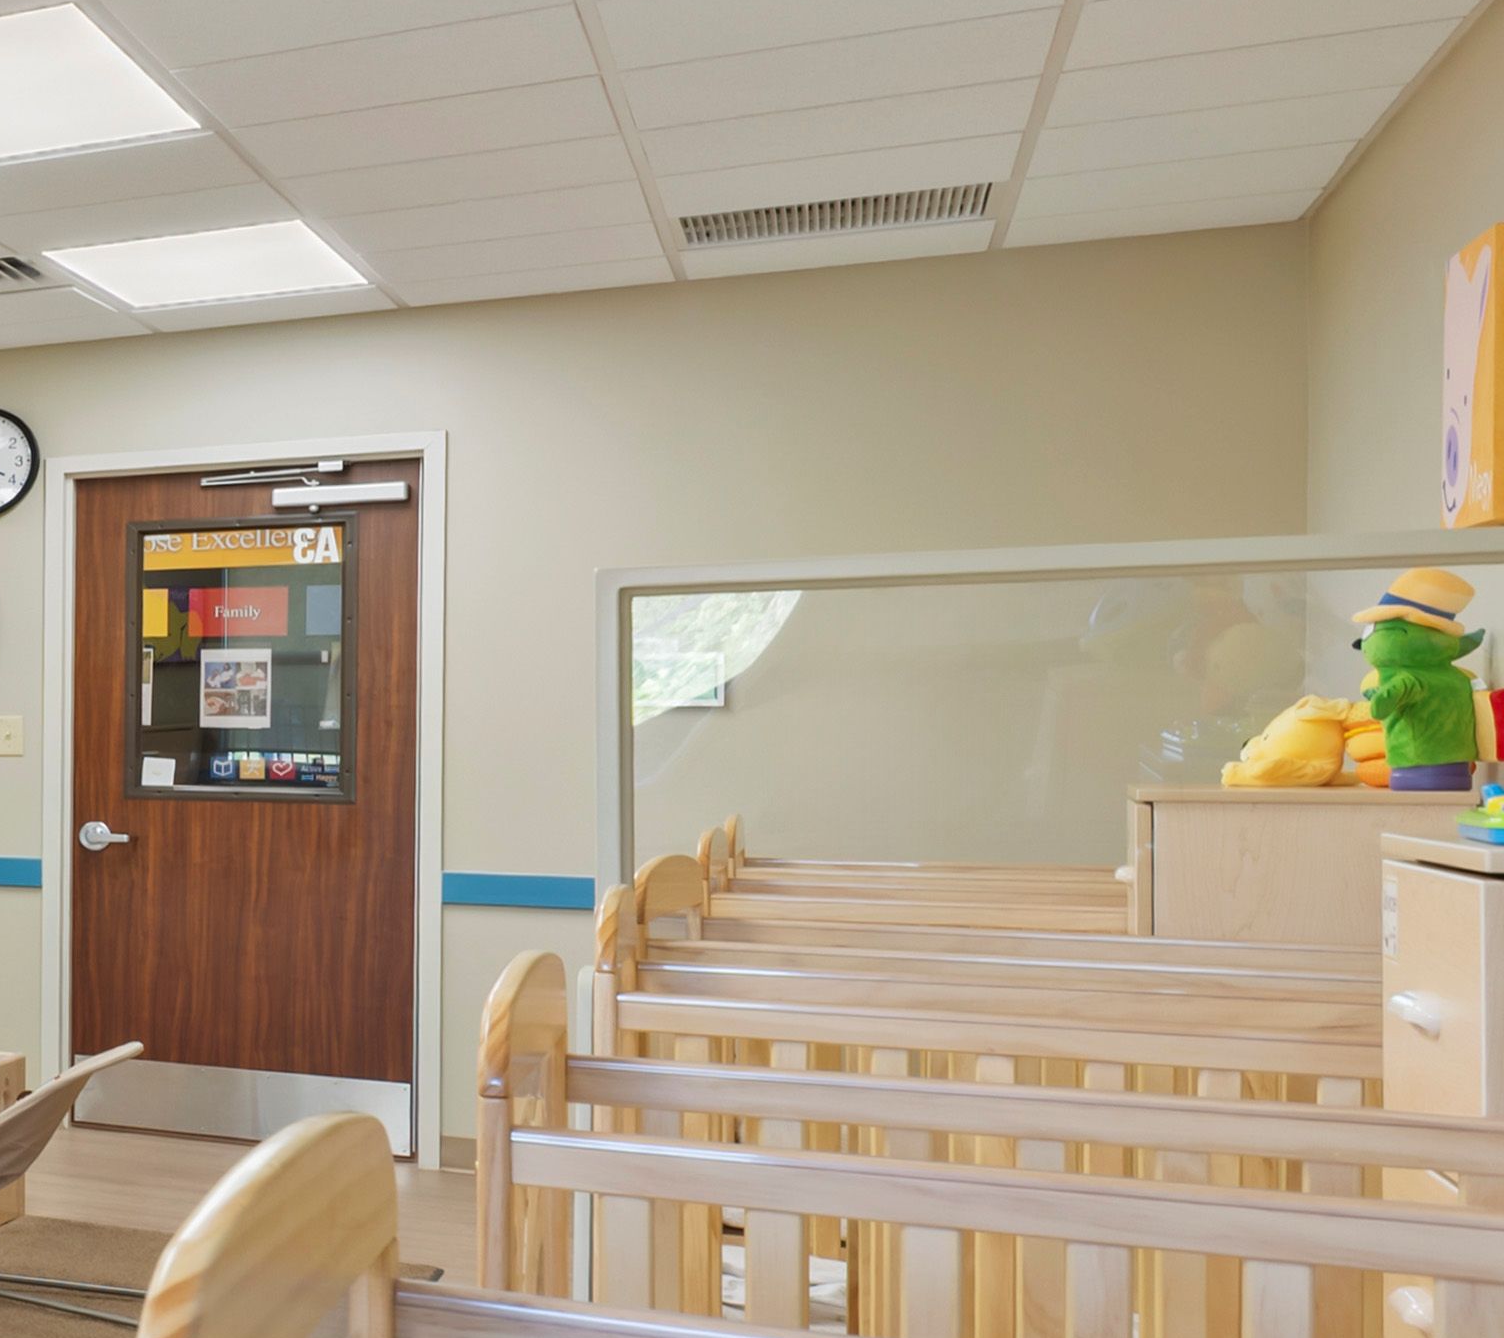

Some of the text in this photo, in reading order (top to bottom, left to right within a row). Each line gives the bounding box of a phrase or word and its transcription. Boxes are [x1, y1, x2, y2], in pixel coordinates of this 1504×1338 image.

[8, 437, 18, 450] 2
[14, 455, 24, 467] 3
[8, 474, 17, 486] 4
[192, 528, 321, 551] Excelle
[214, 605, 262, 621] Family
